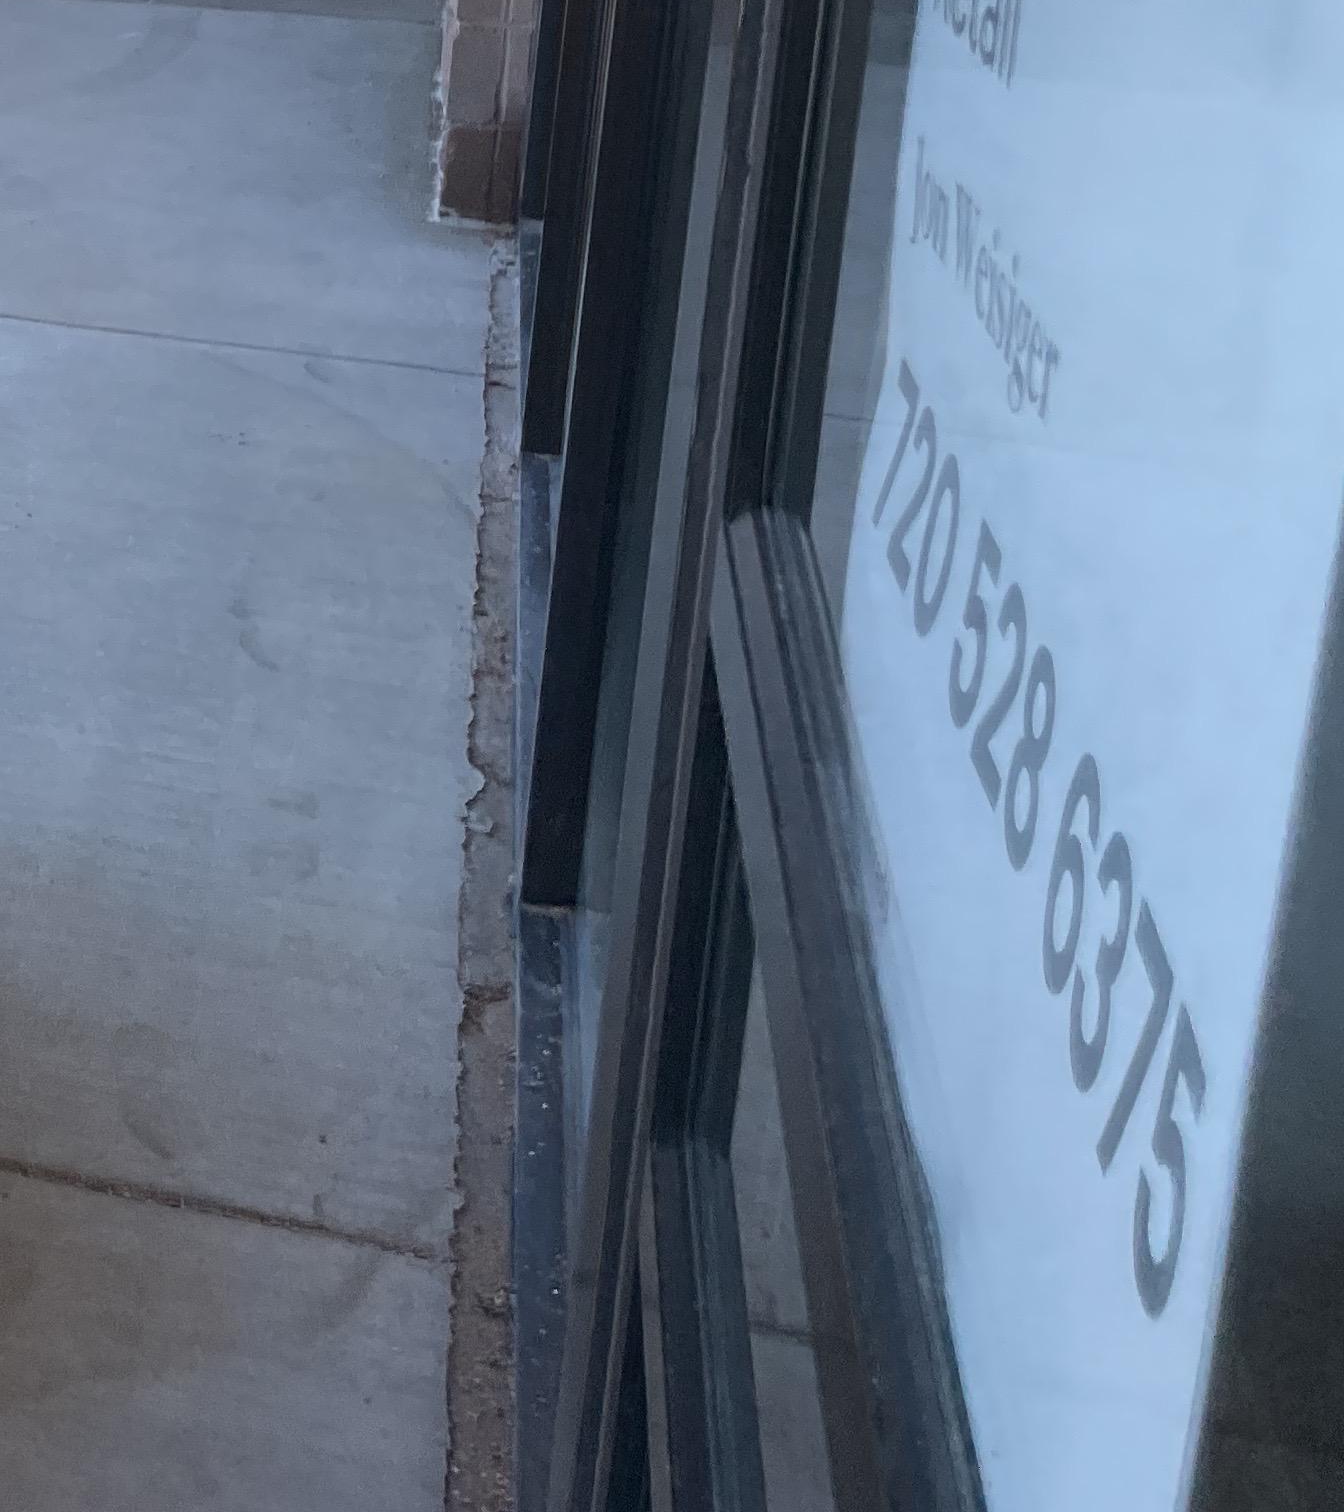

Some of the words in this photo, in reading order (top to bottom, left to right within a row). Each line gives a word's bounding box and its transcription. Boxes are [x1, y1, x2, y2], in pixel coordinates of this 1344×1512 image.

[872, 358, 962, 638] 720
[949, 518, 1057, 871] 528
[1042, 752, 1209, 1321] 6375
